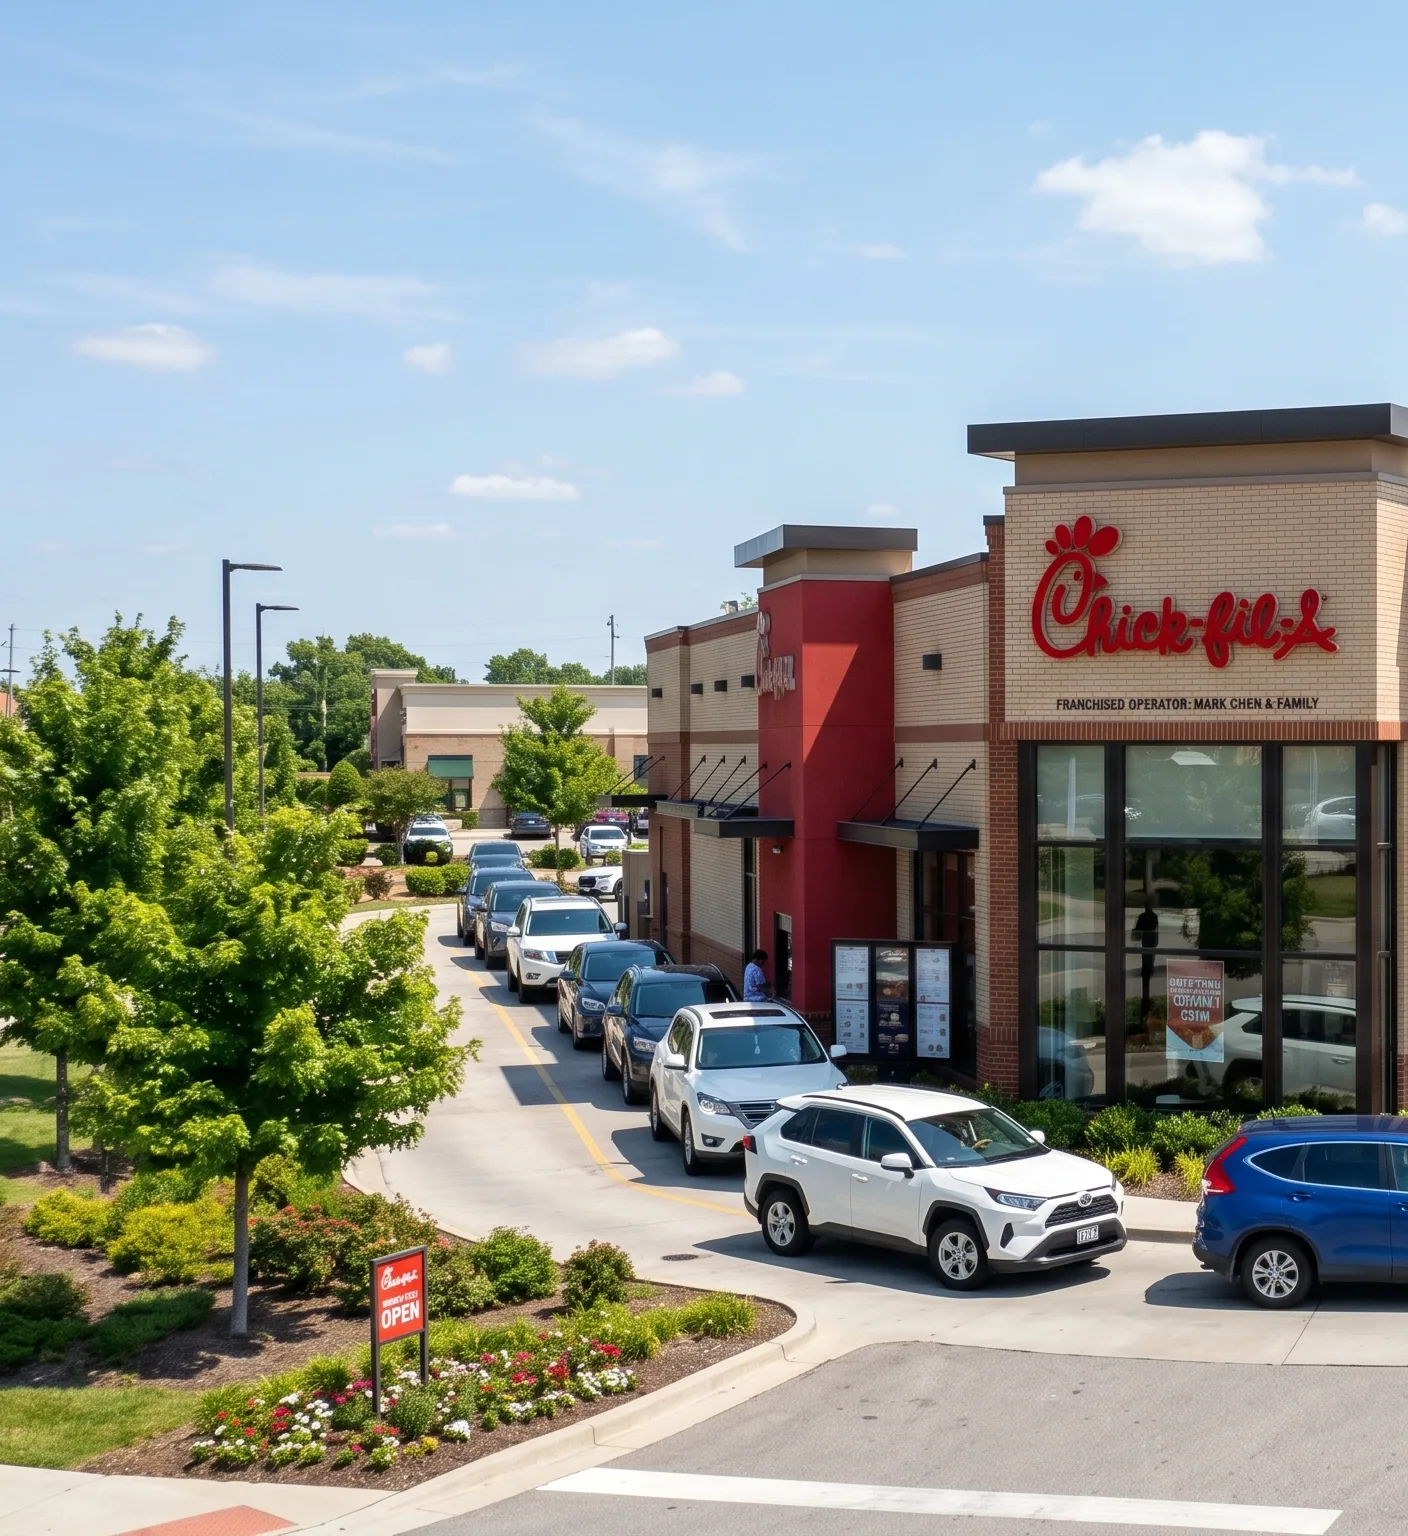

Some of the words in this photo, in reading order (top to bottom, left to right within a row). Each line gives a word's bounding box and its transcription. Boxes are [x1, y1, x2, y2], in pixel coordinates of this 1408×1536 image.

[1031, 515, 1340, 669] Chick-fil-A
[1056, 698, 1125, 711] FRANCHISED
[1128, 698, 1192, 711] OPERATOR:
[1193, 698, 1227, 710] MARK
[1230, 698, 1262, 710] CHEN
[1265, 697, 1273, 709] &
[1277, 697, 1319, 710] FAMILY
[381, 1300, 420, 1329] OPEN
